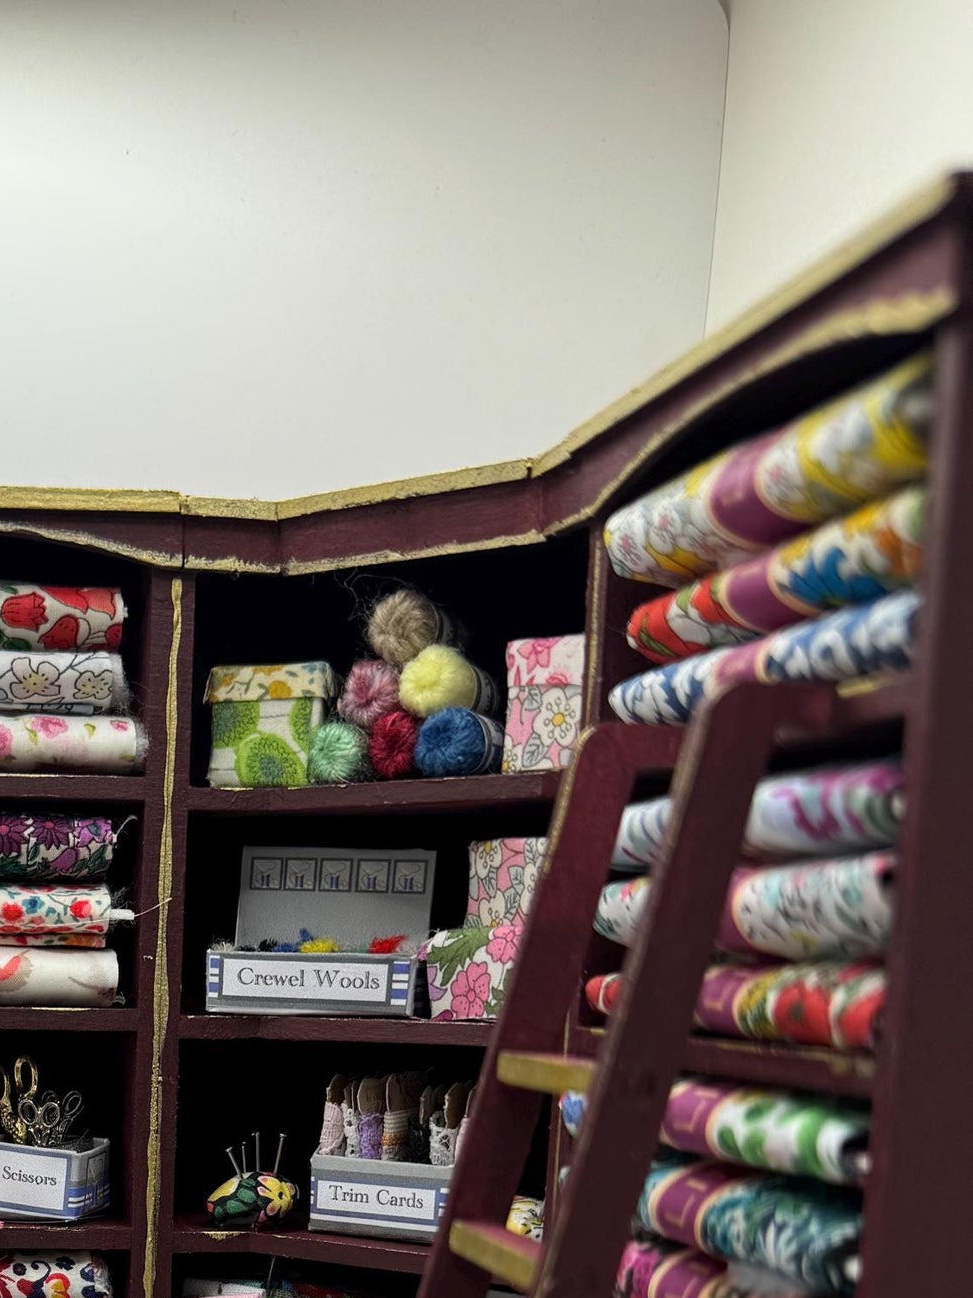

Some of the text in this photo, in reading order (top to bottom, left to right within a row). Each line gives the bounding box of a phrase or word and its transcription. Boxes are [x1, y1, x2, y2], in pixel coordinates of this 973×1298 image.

[237, 967, 381, 990] Crewel Wools
[2, 1166, 58, 1186] Scissors
[328, 1185, 425, 1209] Trim Cards
